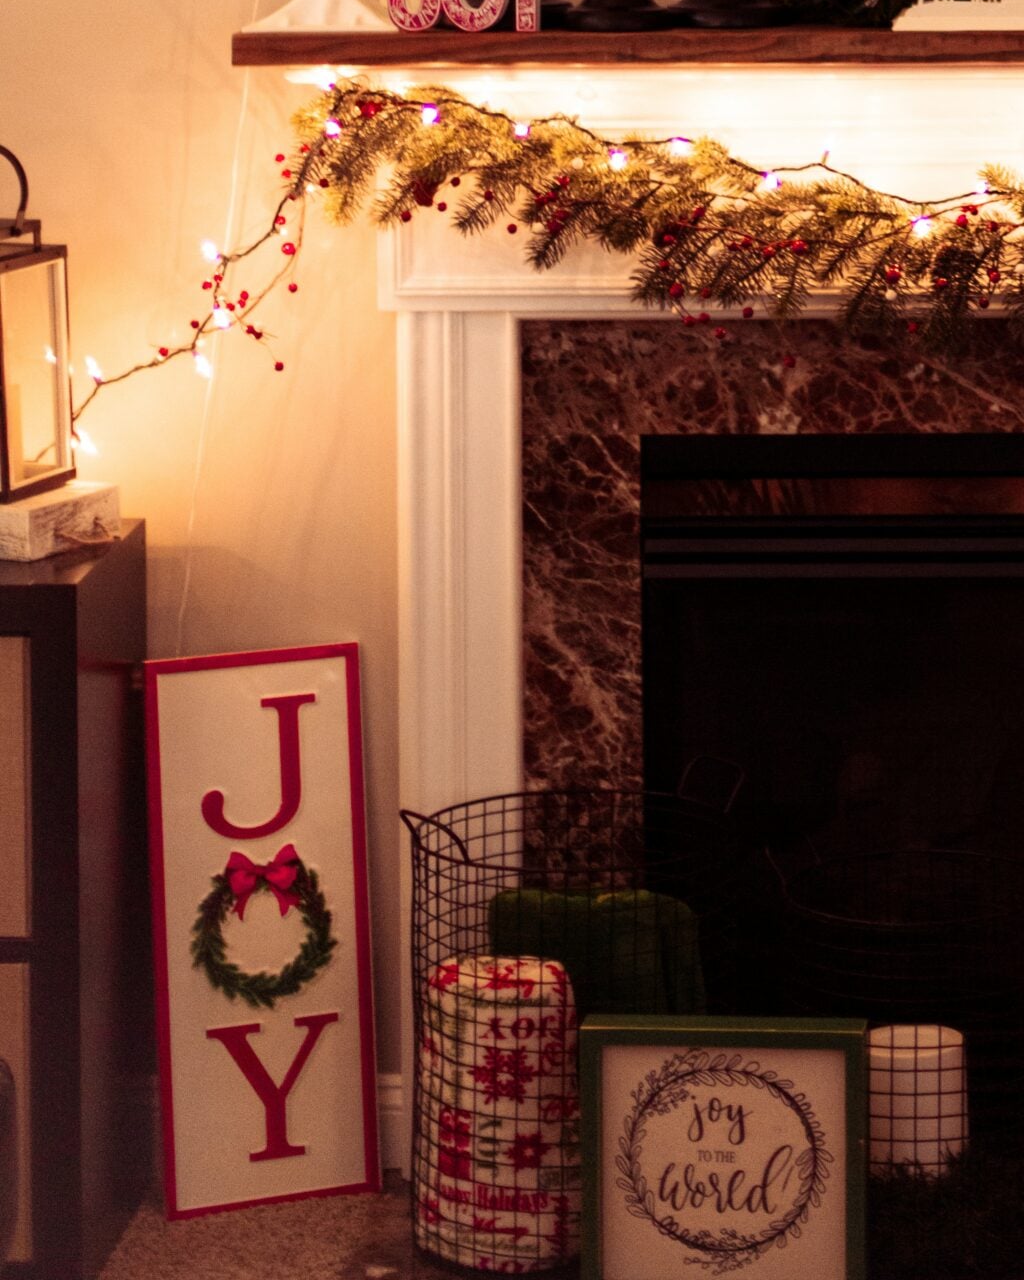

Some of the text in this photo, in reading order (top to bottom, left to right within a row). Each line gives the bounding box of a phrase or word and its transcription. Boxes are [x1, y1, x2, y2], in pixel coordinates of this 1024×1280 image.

[687, 1095, 754, 1145] joy
[697, 1150, 736, 1164] TO THE
